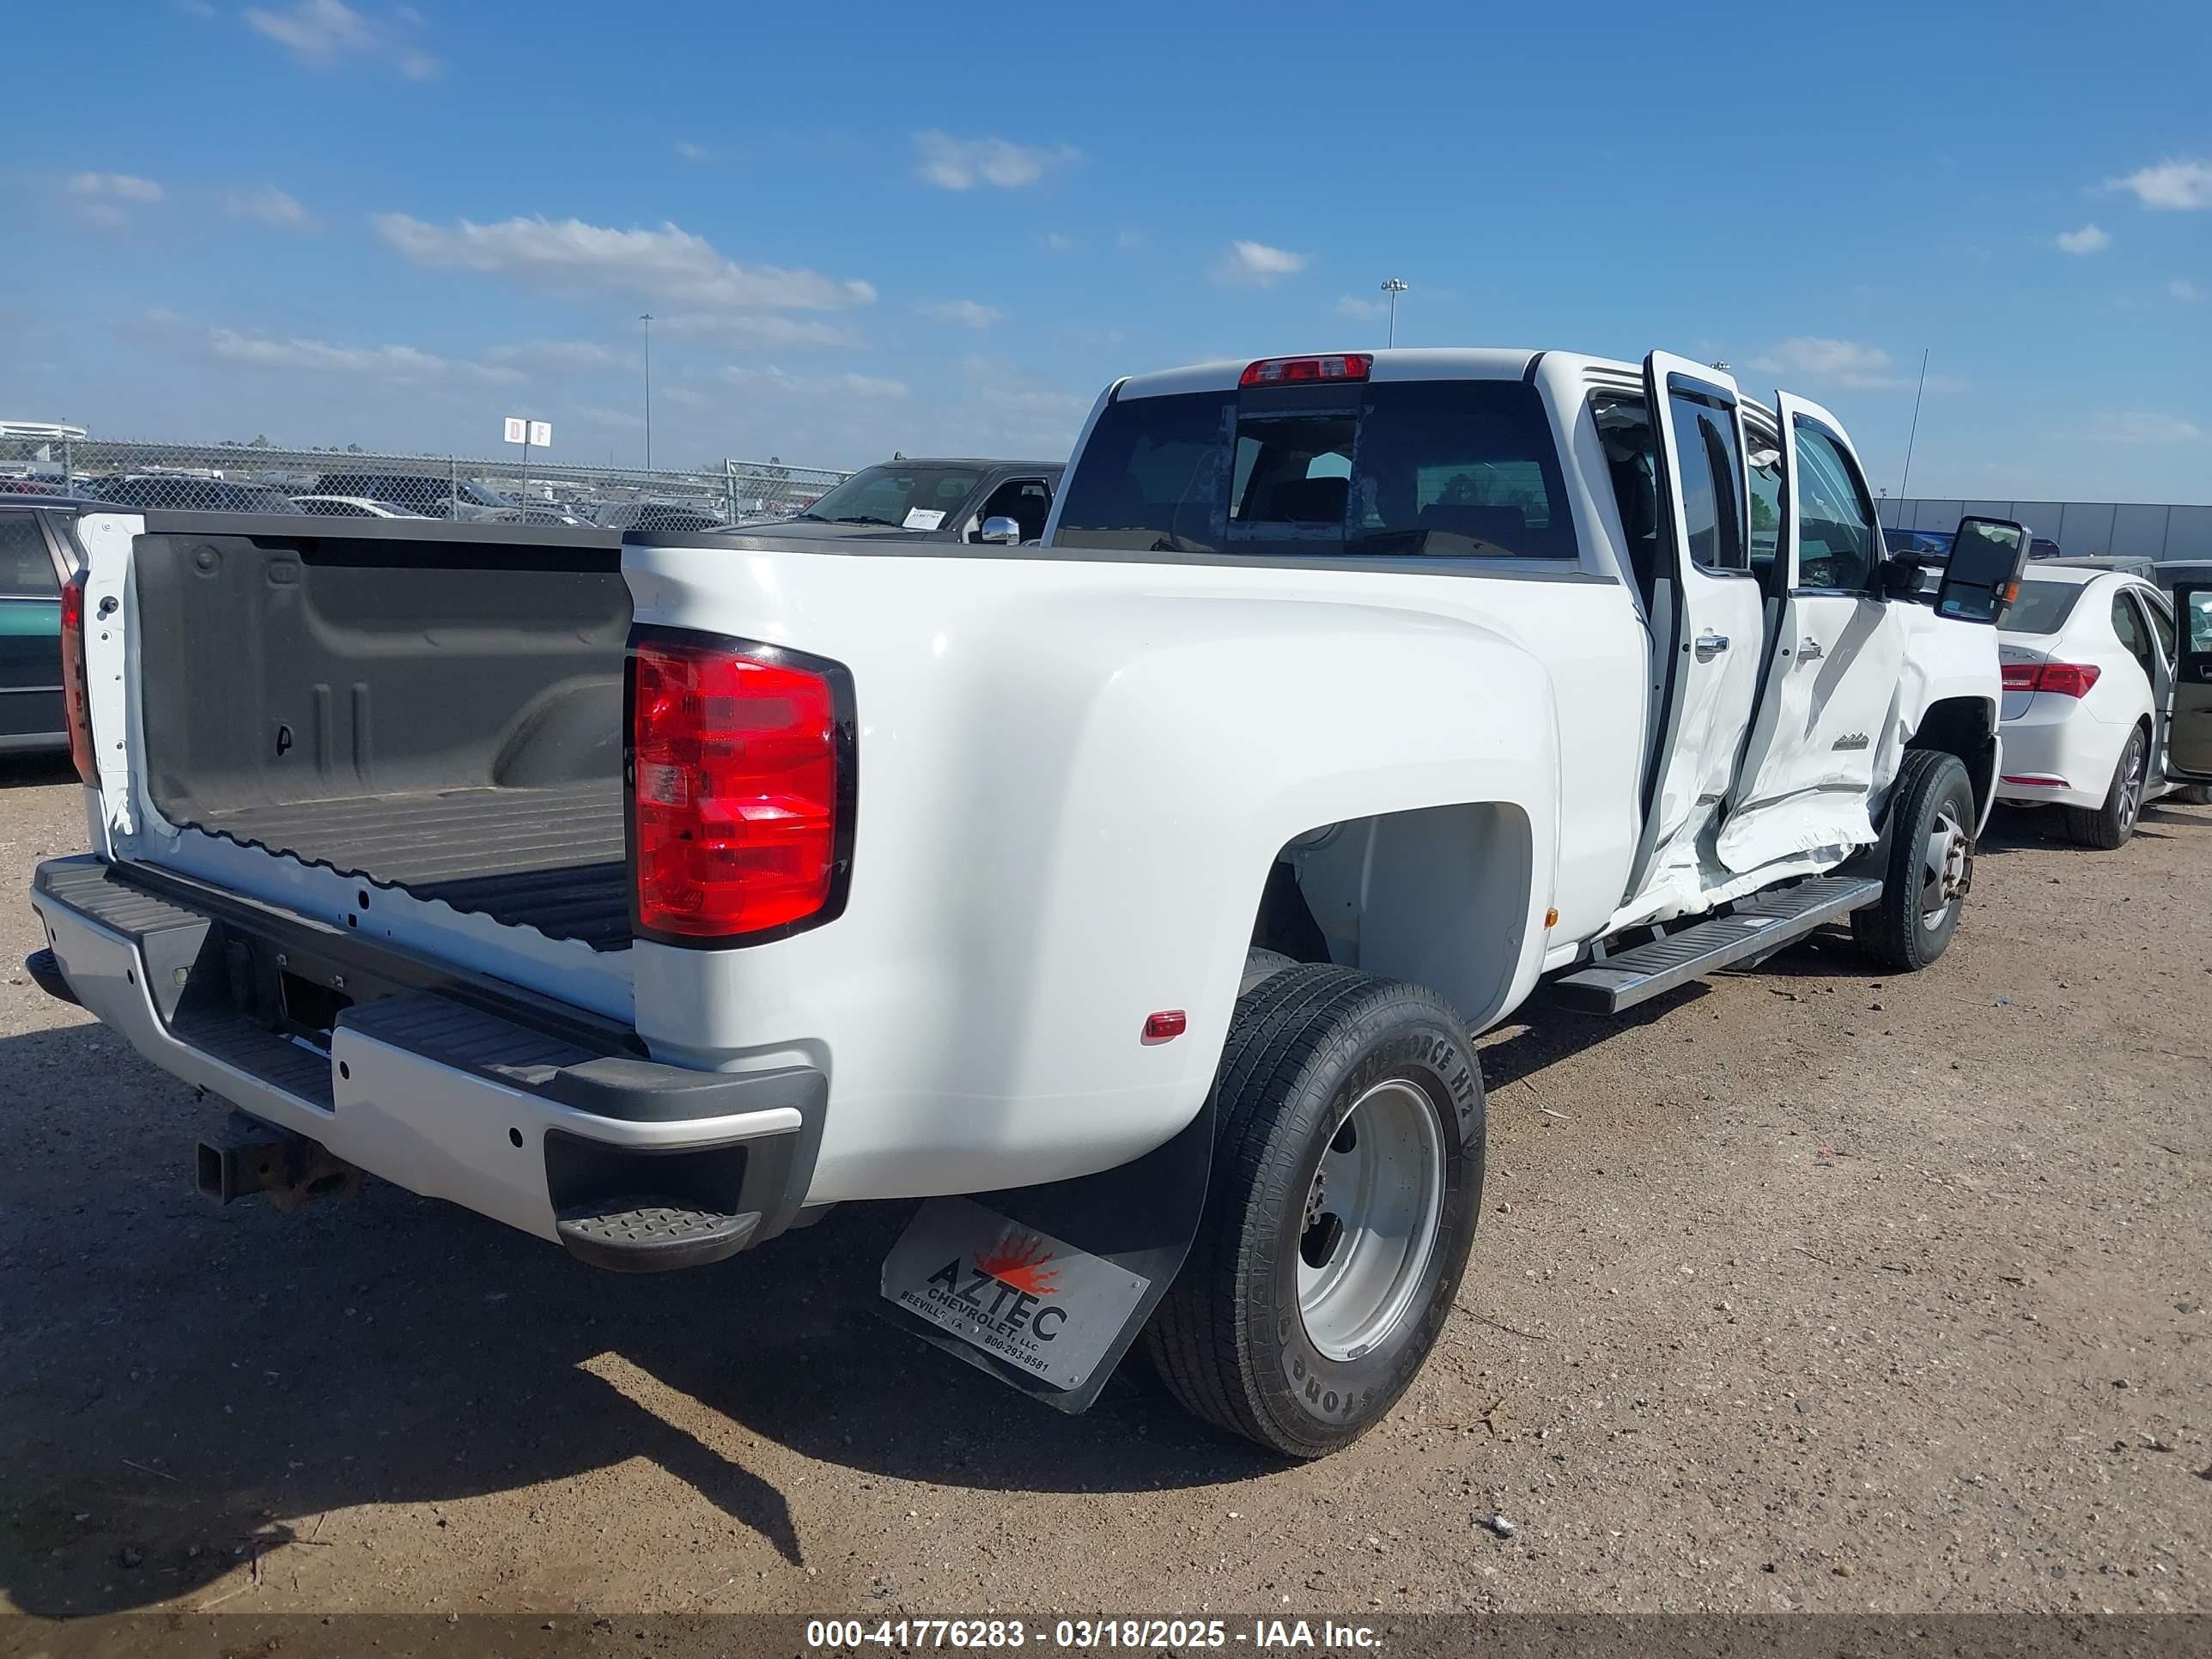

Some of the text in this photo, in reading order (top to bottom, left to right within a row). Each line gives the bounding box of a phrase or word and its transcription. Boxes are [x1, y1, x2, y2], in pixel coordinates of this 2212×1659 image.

[509, 421, 520, 440] D
[537, 424, 545, 443] F
[927, 1256, 1068, 1342] AZTEC
[927, 1287, 1039, 1352] CHEVROLET, LLC
[984, 1334, 1049, 1372] 800-293-8581
